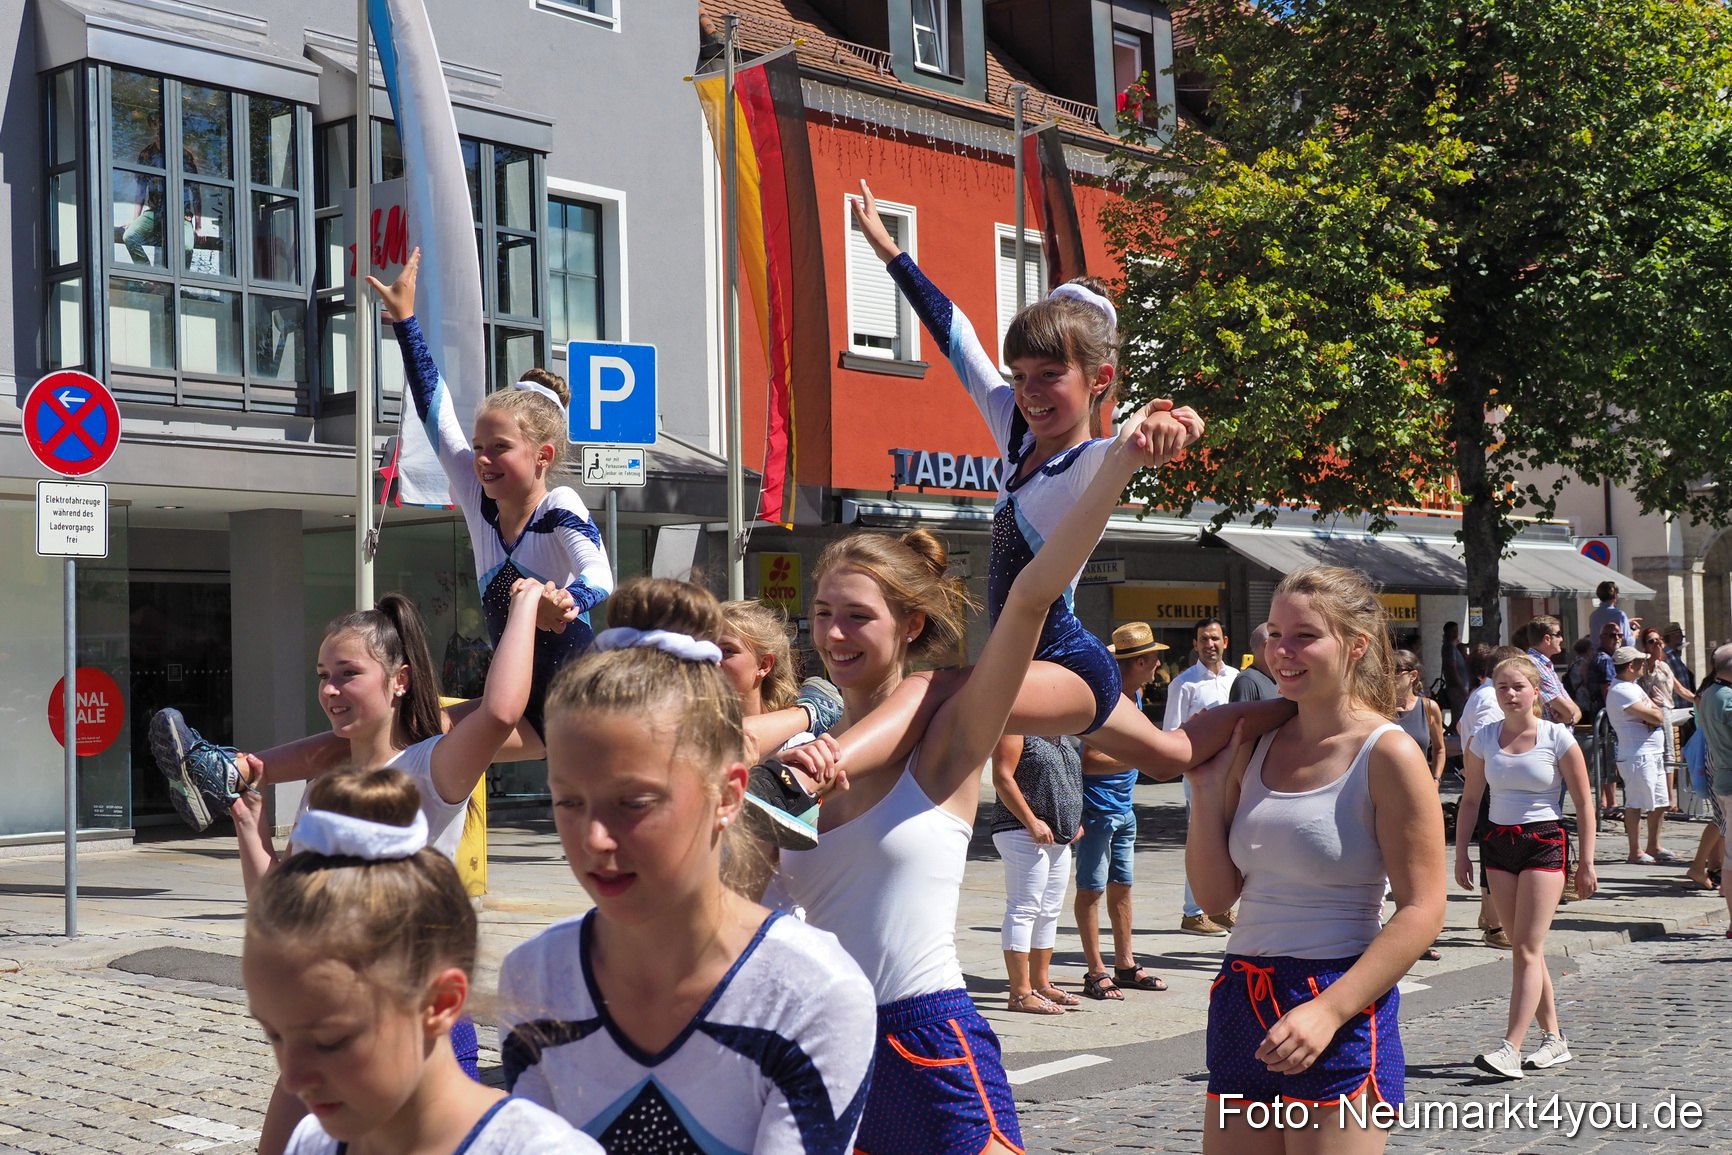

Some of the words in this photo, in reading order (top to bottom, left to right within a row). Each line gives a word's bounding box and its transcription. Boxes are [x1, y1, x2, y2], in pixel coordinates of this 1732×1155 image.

[590, 355, 636, 430] P
[888, 448, 1002, 492] TABAK
[45, 494, 101, 507] Elektrofahrzeuge
[52, 508, 81, 518] während
[82, 509, 94, 518] des
[49, 522, 95, 534] Ladevorgangs
[66, 535, 78, 544] frei
[764, 586, 797, 600] LOTTO
[63, 691, 109, 708] NAL
[76, 708, 106, 725] ALE
